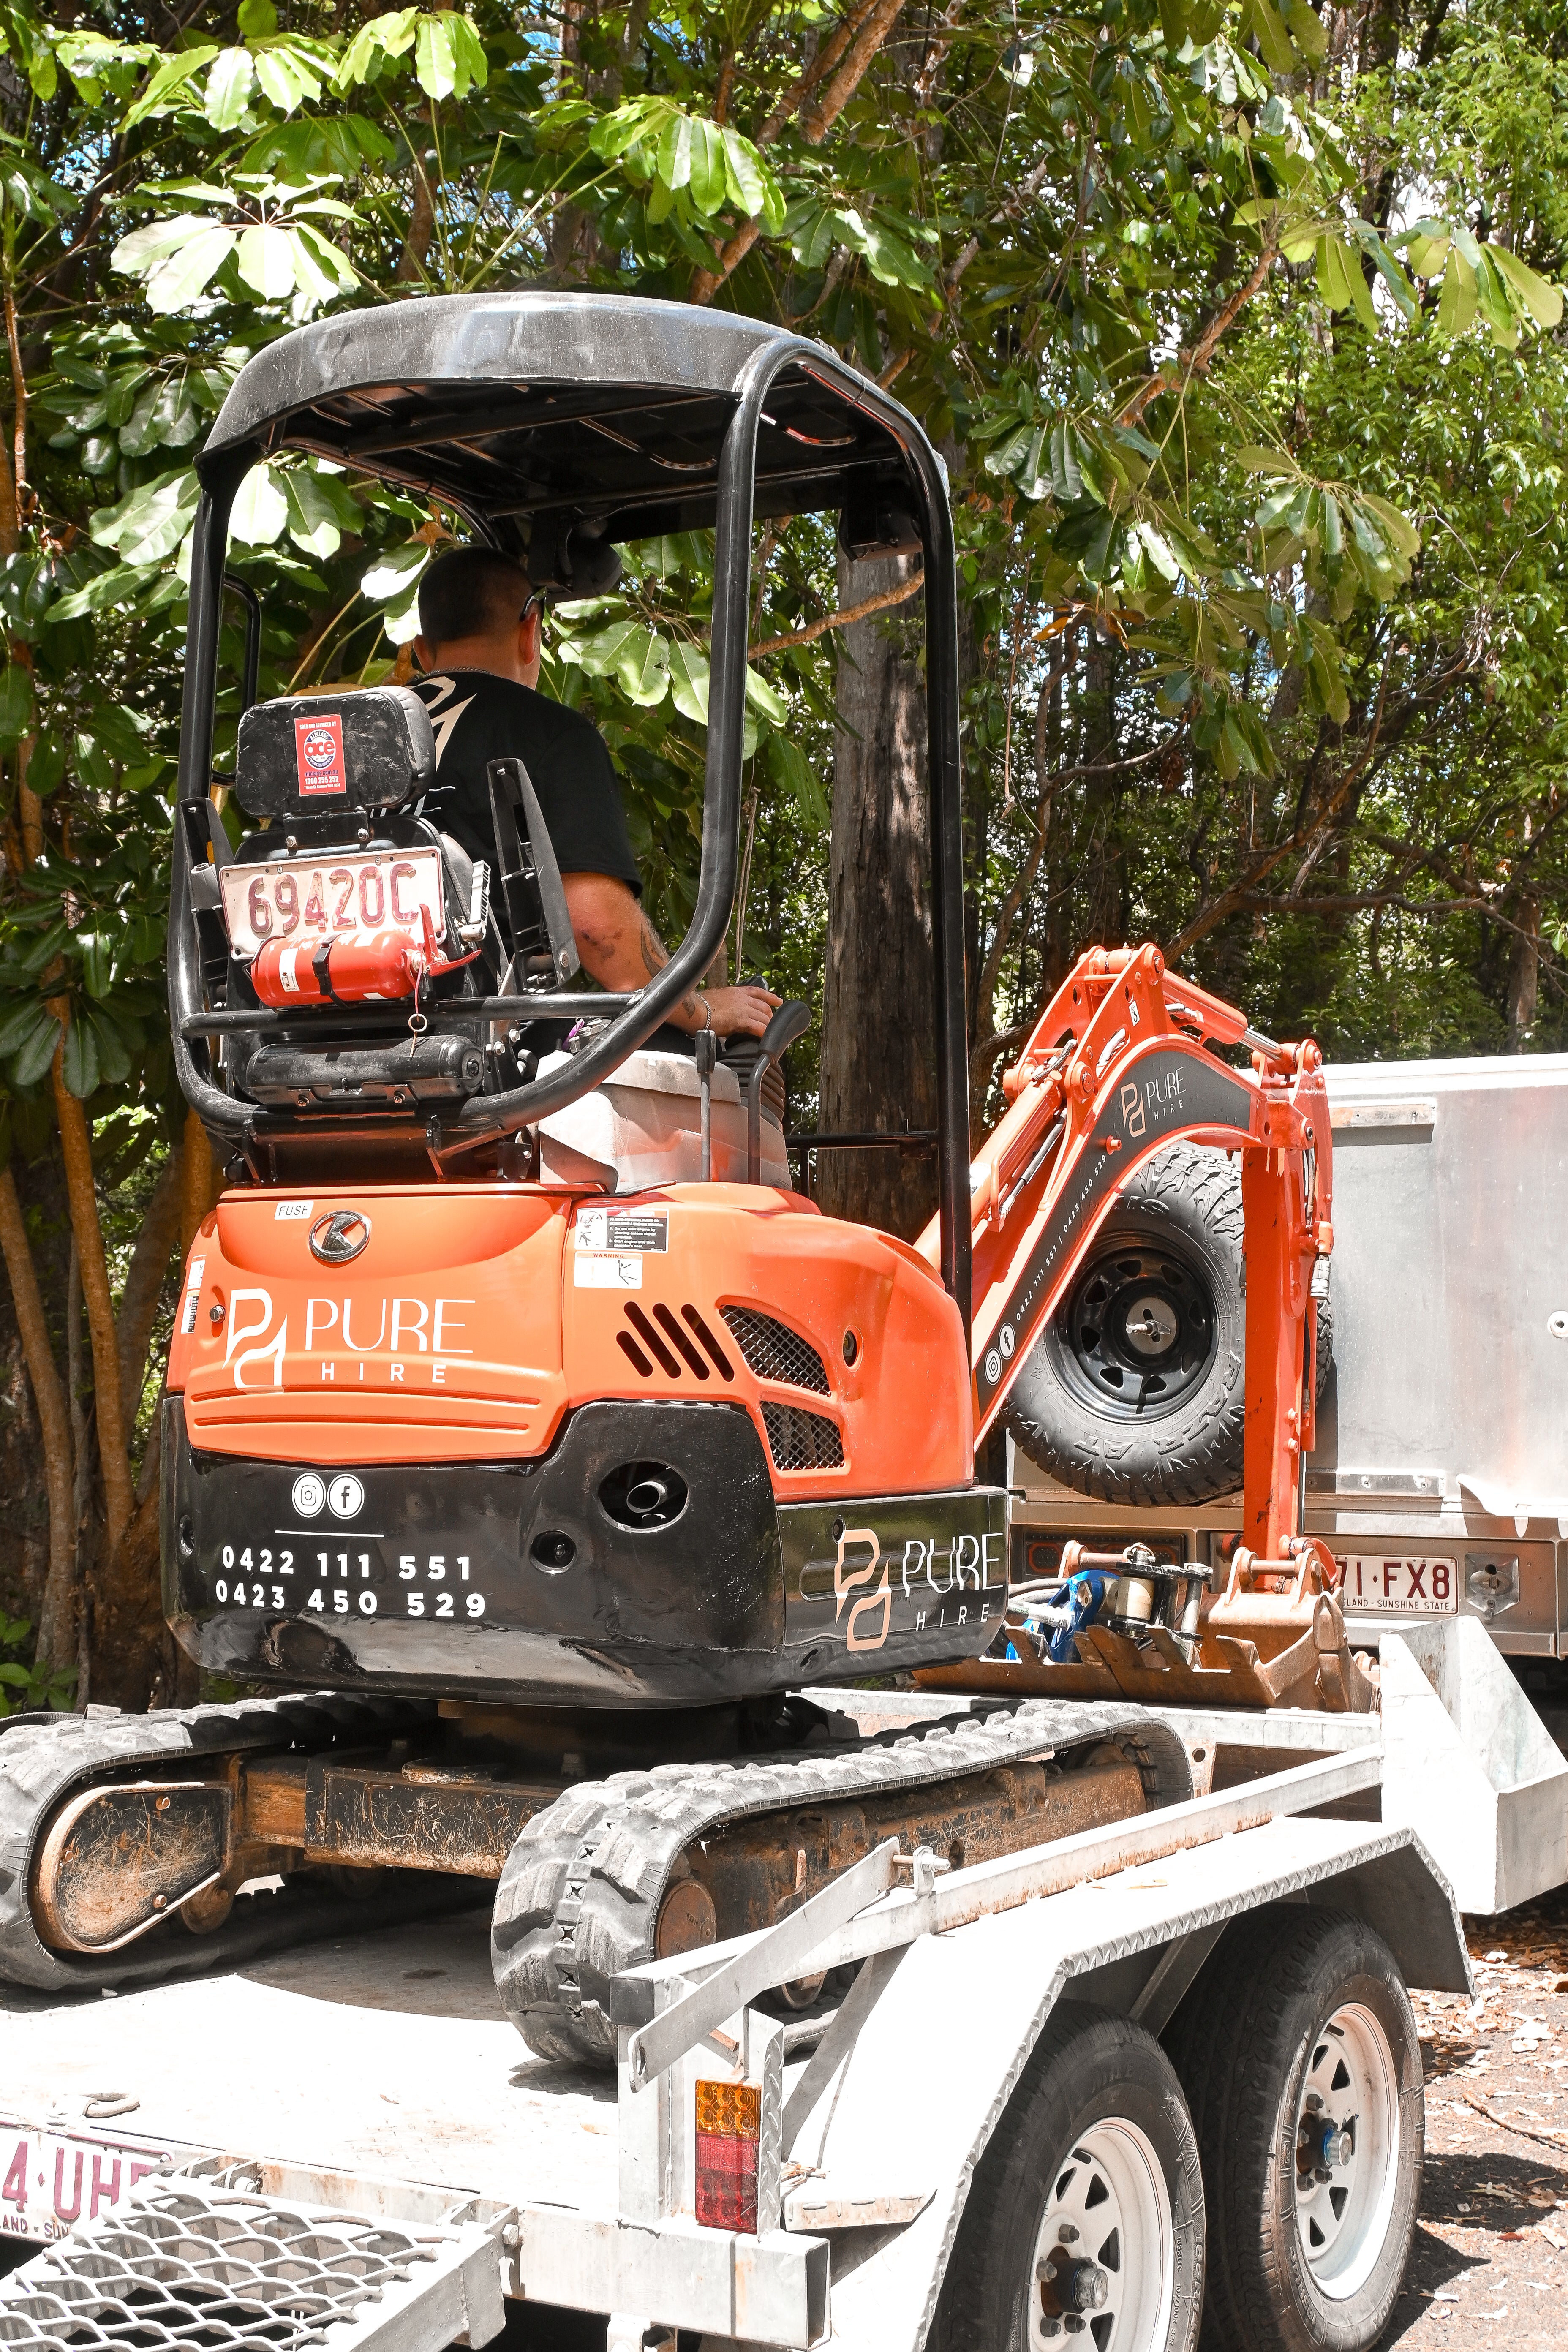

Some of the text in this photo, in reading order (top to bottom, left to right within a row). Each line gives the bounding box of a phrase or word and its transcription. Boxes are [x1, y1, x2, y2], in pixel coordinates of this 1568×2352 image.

[305, 741, 335, 757] ace
[329, 775, 339, 783] 252
[248, 863, 419, 934] 69420C
[1146, 1066, 1187, 1108] PURE
[1154, 1099, 1183, 1120] HIRE
[279, 1205, 310, 1217] FUSE
[1016, 1154, 1106, 1321] 0422 111 551 0423 450 529
[305, 1298, 476, 1354] PURE
[321, 1363, 446, 1384] HIRE
[222, 1545, 470, 1580] 0422 111 551
[902, 1532, 1004, 1598] PURE
[215, 1579, 485, 1617] 0423 450 529
[1377, 1600, 1419, 1610] SUNSHINE
[1424, 1601, 1450, 1611] STATE
[915, 1603, 990, 1631] HIRE
